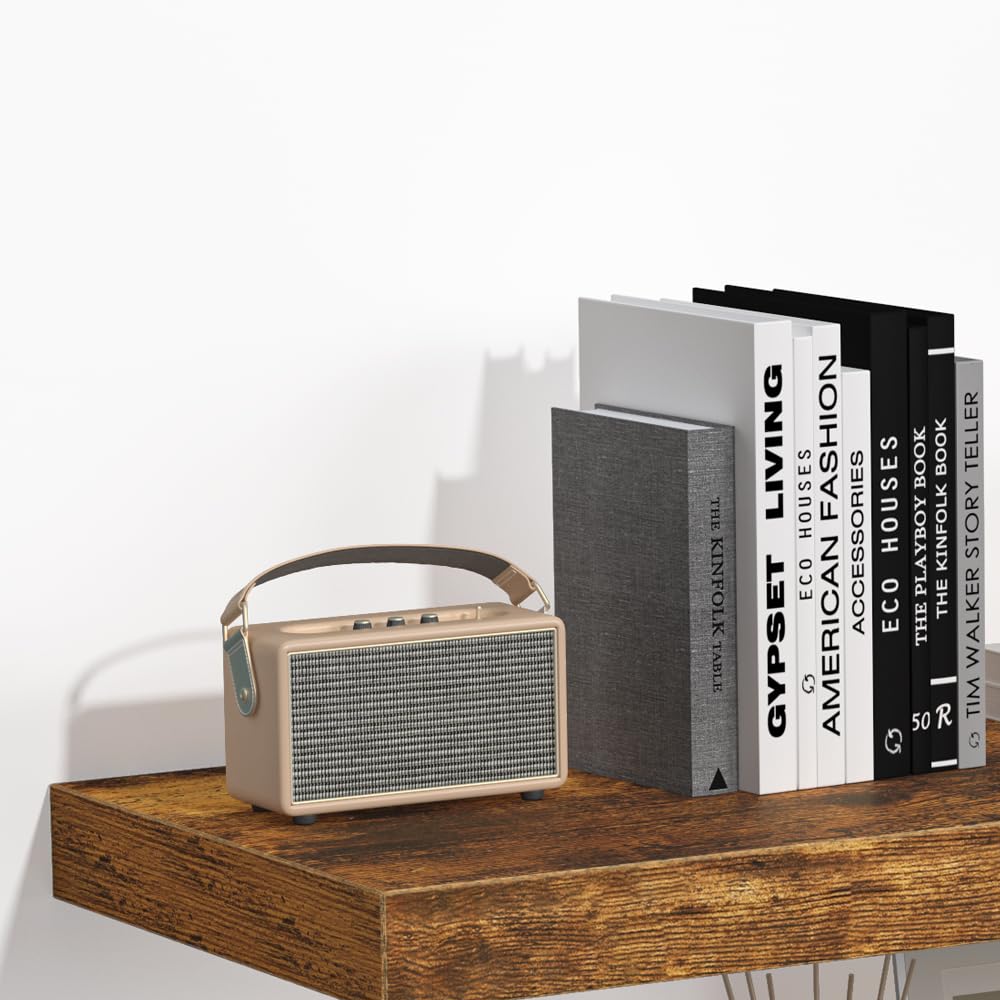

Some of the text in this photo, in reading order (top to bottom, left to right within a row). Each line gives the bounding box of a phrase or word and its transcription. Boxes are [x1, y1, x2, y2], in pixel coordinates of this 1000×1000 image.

[710, 496, 725, 694] THE KINFOLK TABLE
[763, 364, 787, 738] GYPSET LIVING
[797, 447, 814, 601] ECO HOUSES
[817, 354, 841, 737] AMERICAN FASHION
[849, 449, 866, 636] ACCESSORIES
[879, 436, 900, 633] ECO HOUSES
[913, 426, 928, 647] THE PLAYBOY BOOK
[934, 417, 948, 620] THE KINFOLK BOOK
[964, 392, 981, 719] TIM WALKER STORY TELLER
[912, 711, 931, 731] 50
